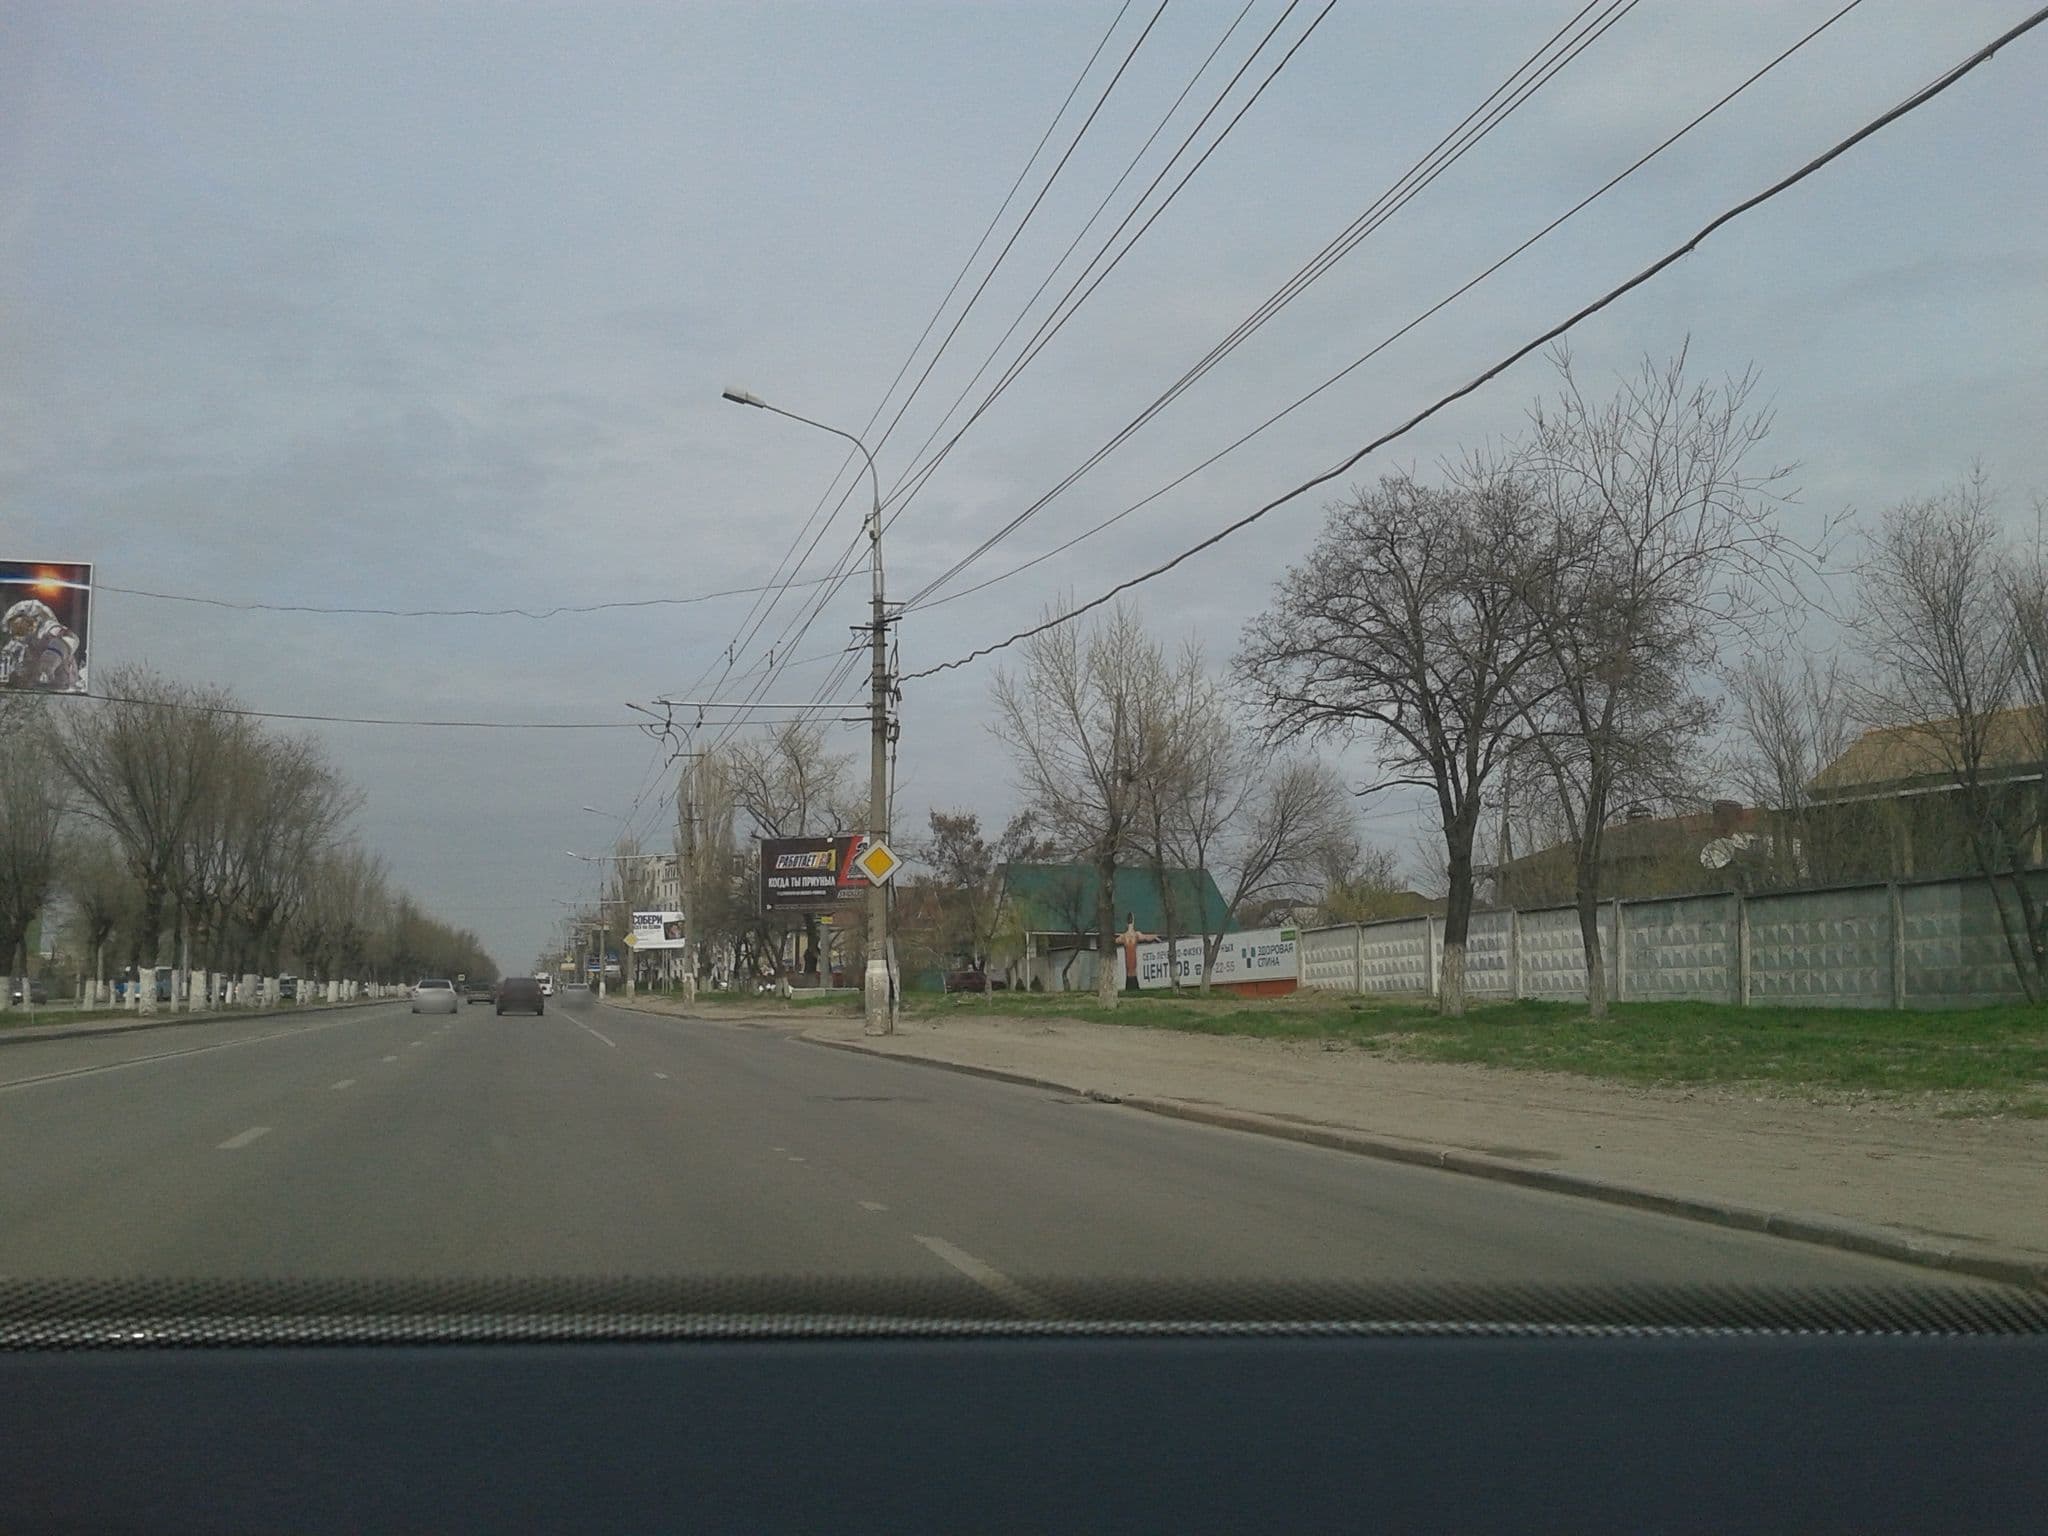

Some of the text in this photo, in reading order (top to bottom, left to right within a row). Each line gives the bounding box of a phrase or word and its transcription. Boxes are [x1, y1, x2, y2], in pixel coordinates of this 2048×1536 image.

[769, 876, 836, 888] КОГДА ТЫ ПРИУНЫЛ
[632, 915, 663, 925] СОБЕРИ
[1257, 942, 1294, 955] ЗДОРОВАЯ
[1142, 952, 1155, 961] СЕТЬ
[1257, 957, 1281, 967] СПИНА
[1143, 960, 1190, 982] ЦЕНТОВ
